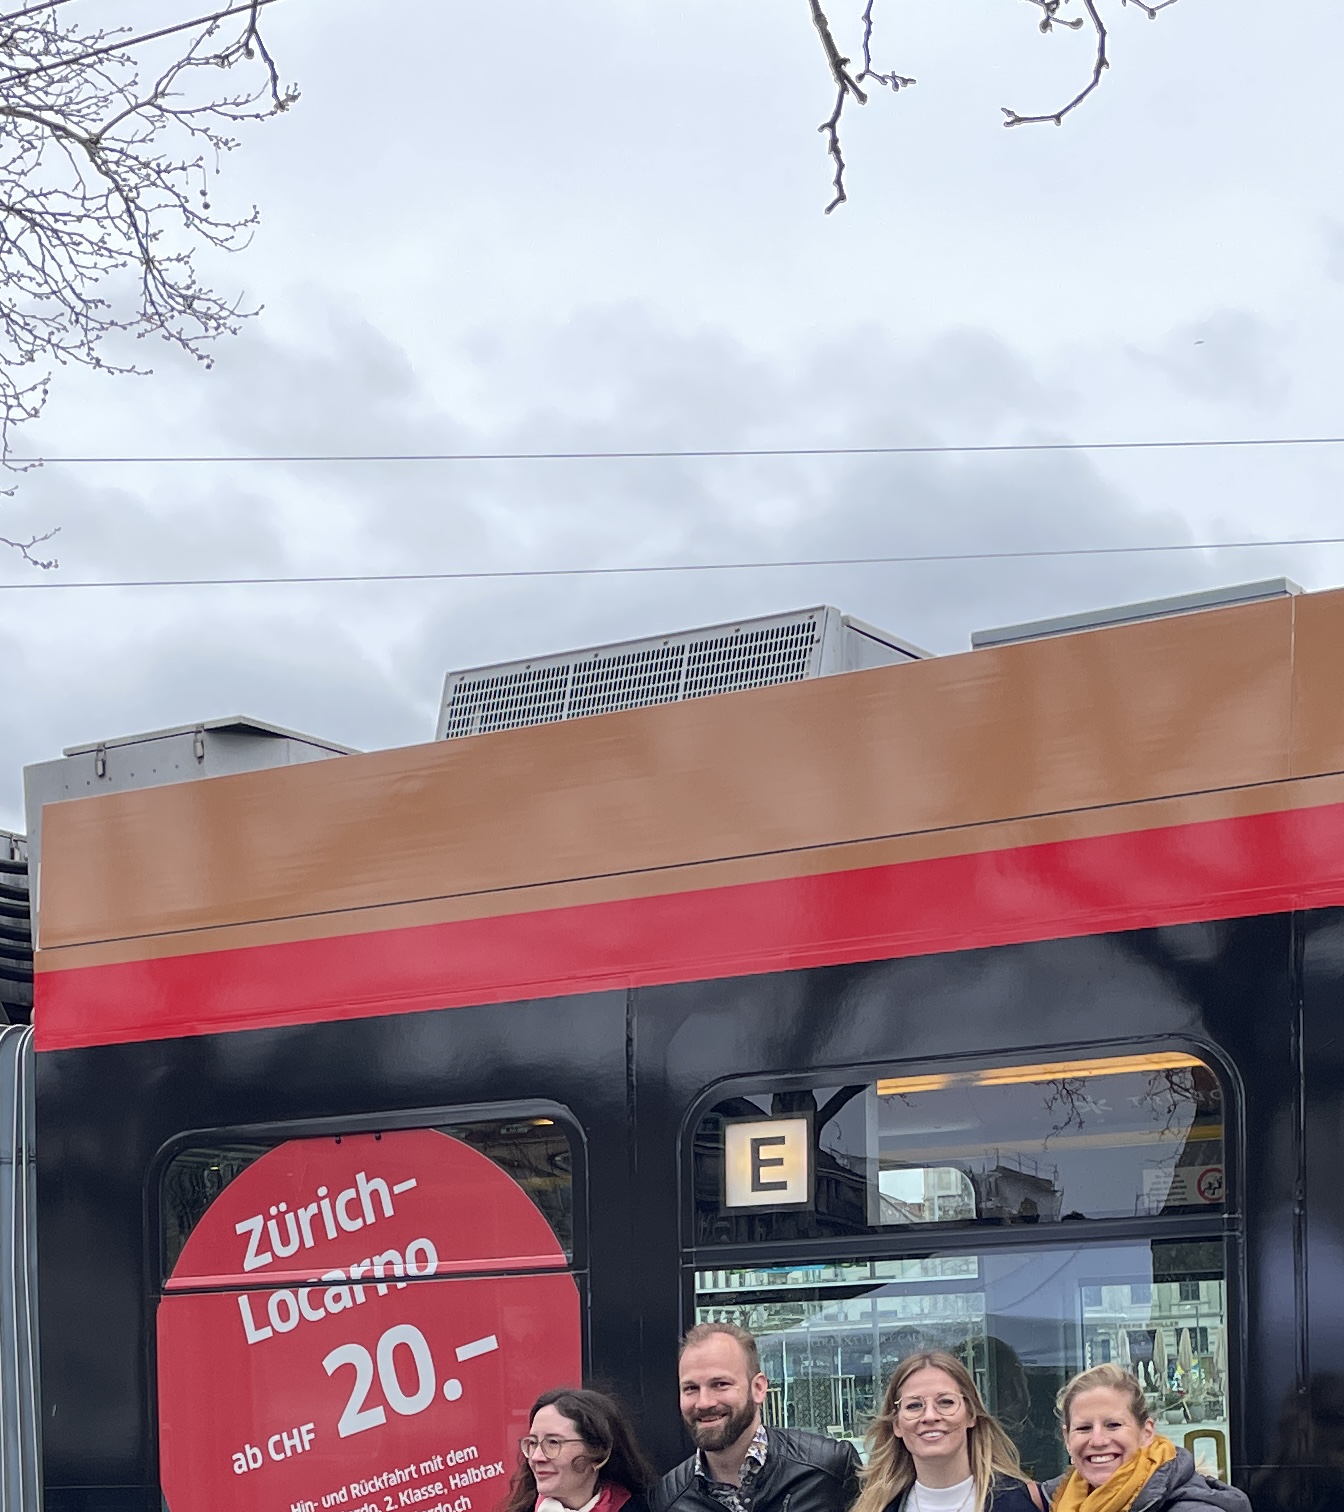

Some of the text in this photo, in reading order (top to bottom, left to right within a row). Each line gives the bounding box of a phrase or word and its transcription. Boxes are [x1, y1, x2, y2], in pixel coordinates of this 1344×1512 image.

[750, 1135, 788, 1192] E
[235, 1171, 417, 1272] Zürich-
[237, 1237, 438, 1345] Locarno
[322, 1323, 499, 1438] 20.-
[232, 1422, 316, 1475] ab CHF
[321, 1486, 348, 1509] und
[350, 1464, 418, 1500] Rückfahrt
[419, 1454, 445, 1477] mit
[446, 1444, 478, 1468] dem
[383, 1495, 399, 1512] 2.
[398, 1480, 449, 1508] Klasse,
[448, 1460, 505, 1491] Halbtax
